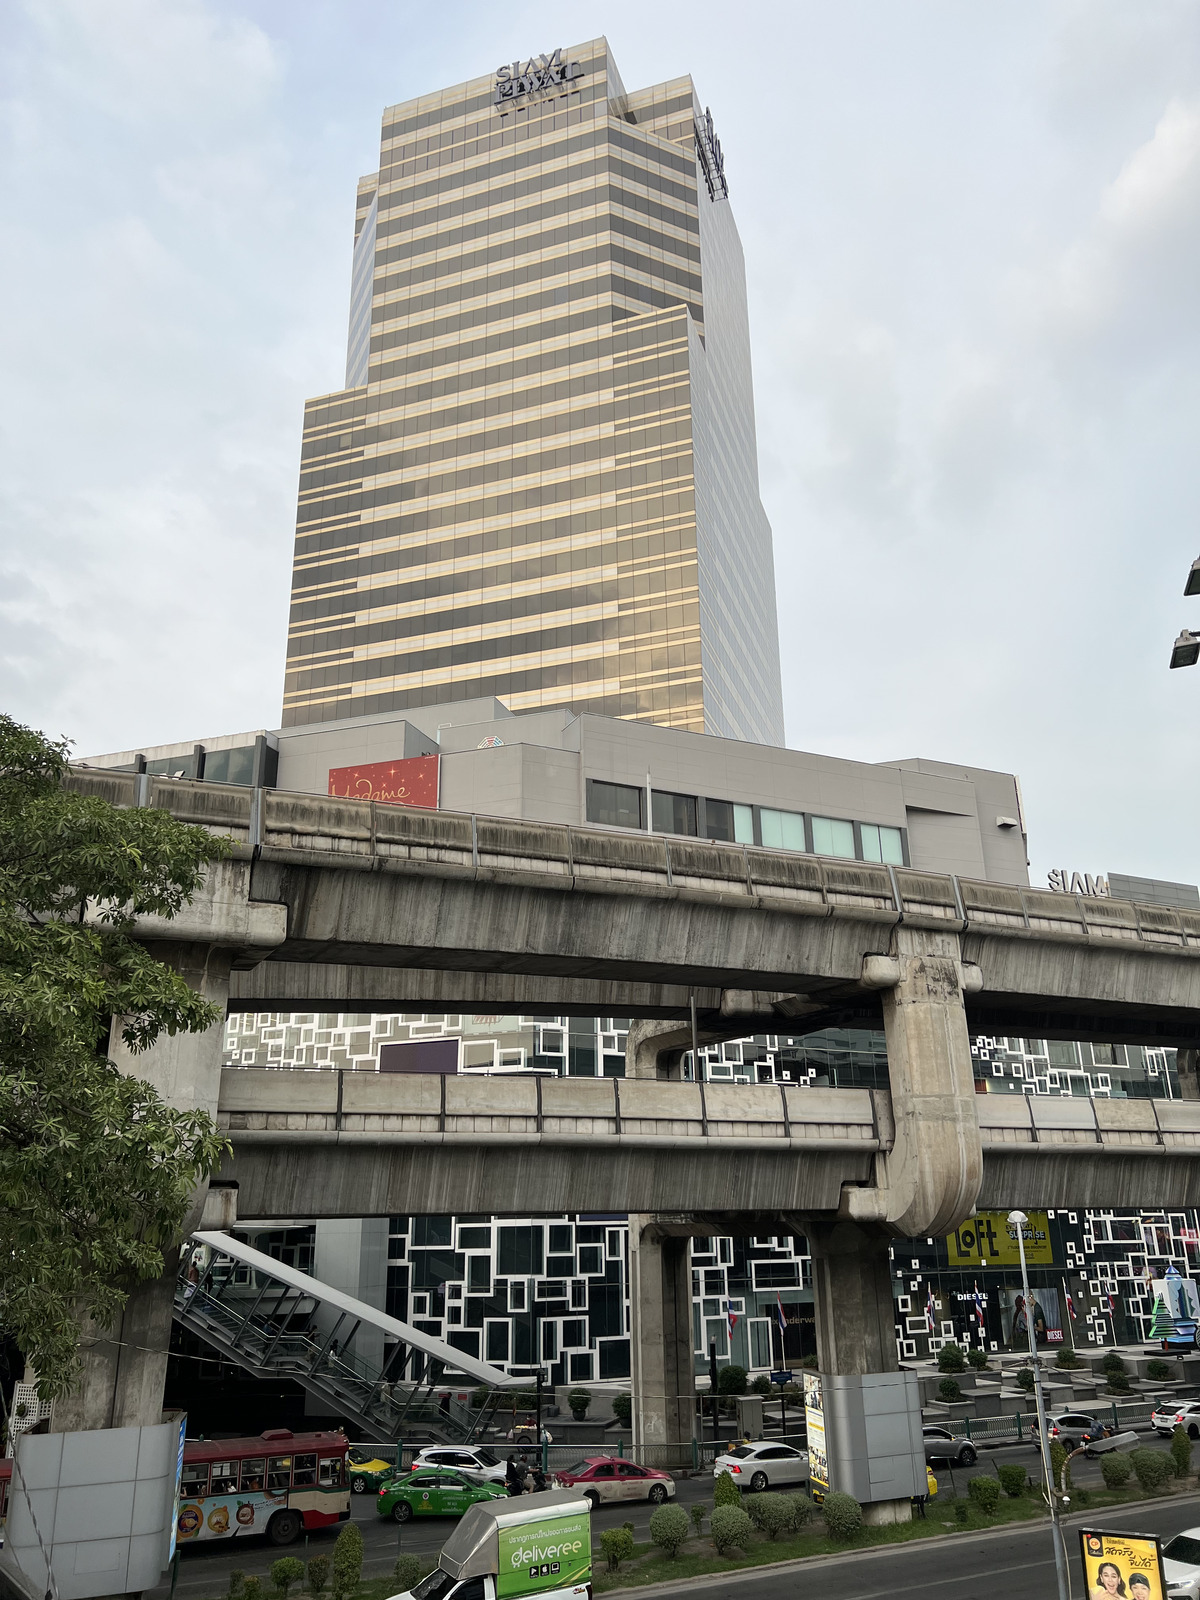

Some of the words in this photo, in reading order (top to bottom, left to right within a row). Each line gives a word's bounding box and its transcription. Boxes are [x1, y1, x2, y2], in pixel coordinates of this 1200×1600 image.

[496, 48, 562, 84] SIAM
[1047, 868, 1109, 898] SIAM
[957, 1292, 989, 1301] DIESEL
[1046, 1330, 1064, 1340] DIESEL
[511, 1540, 583, 1568] deliveree
